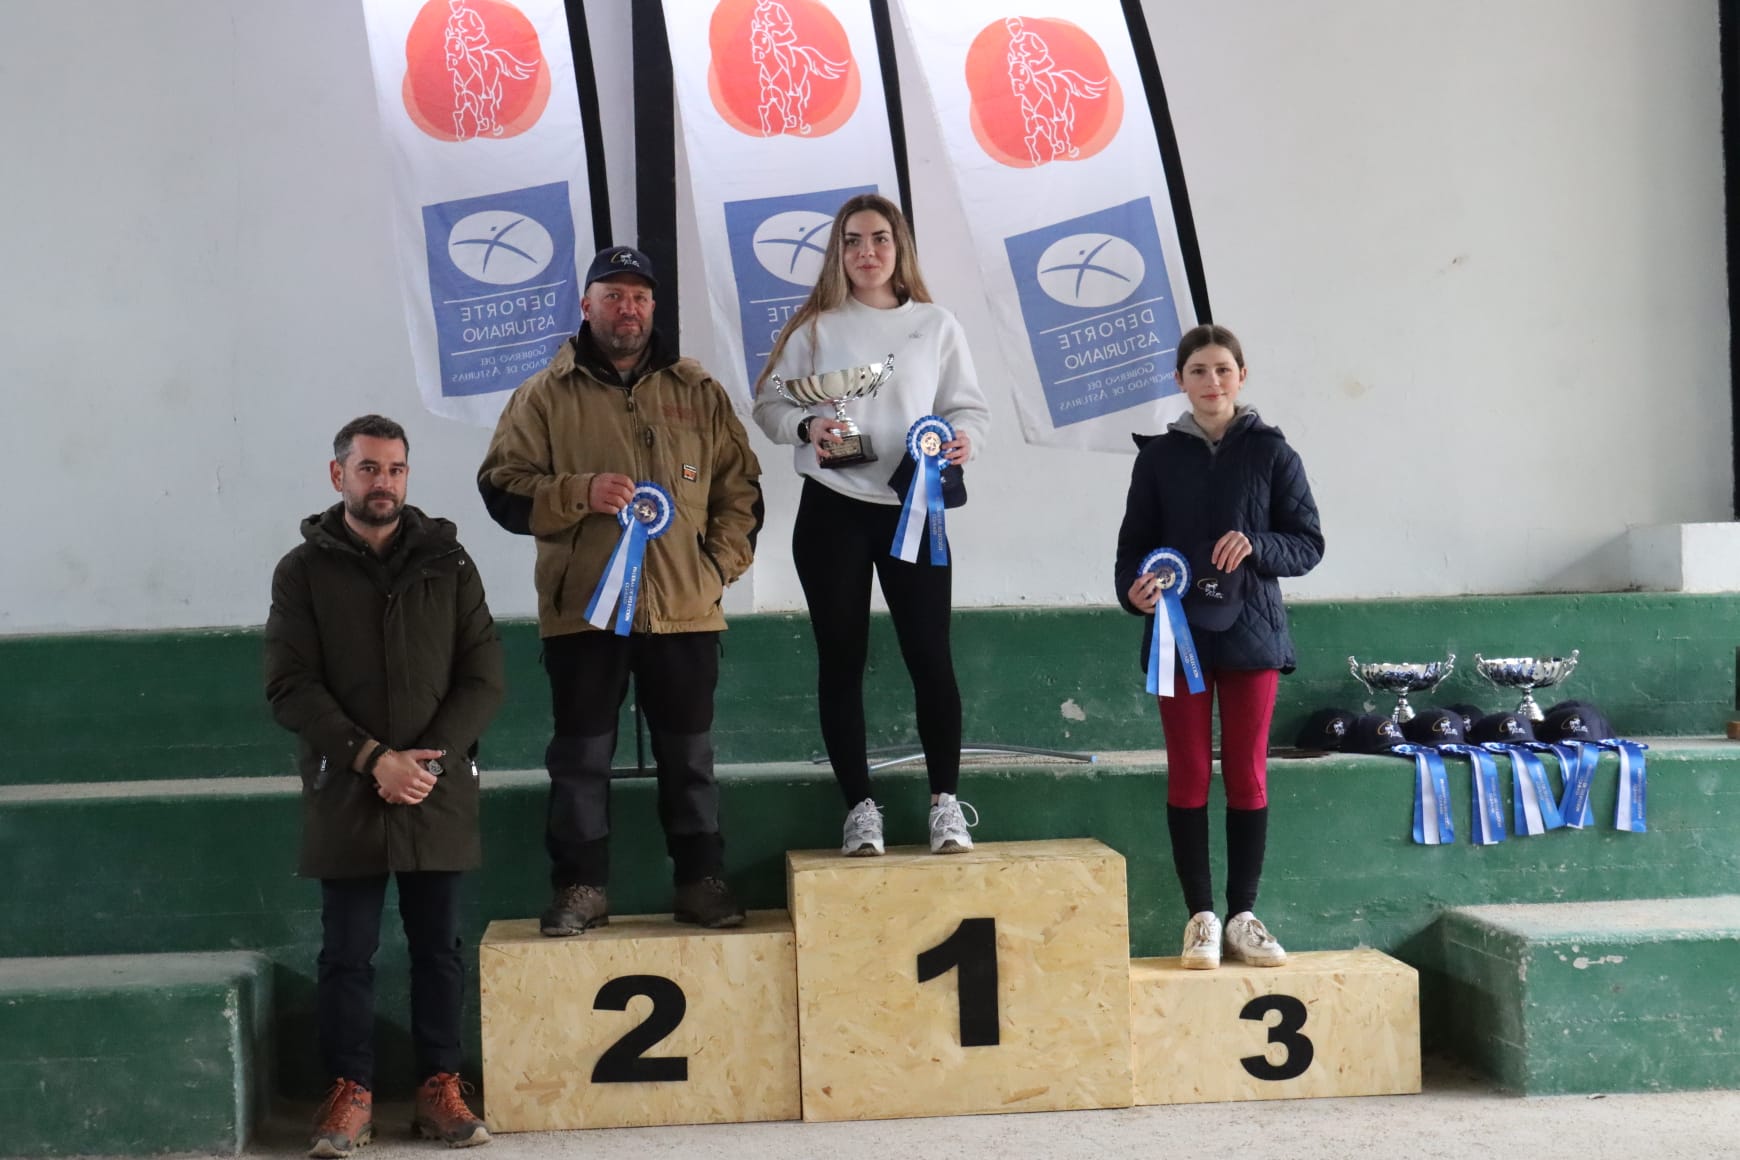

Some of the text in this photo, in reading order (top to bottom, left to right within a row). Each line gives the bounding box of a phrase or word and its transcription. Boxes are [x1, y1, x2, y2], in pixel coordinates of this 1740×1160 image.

[591, 975, 688, 1083] 2
[917, 918, 999, 1047] 1
[1240, 995, 1313, 1080] 3
